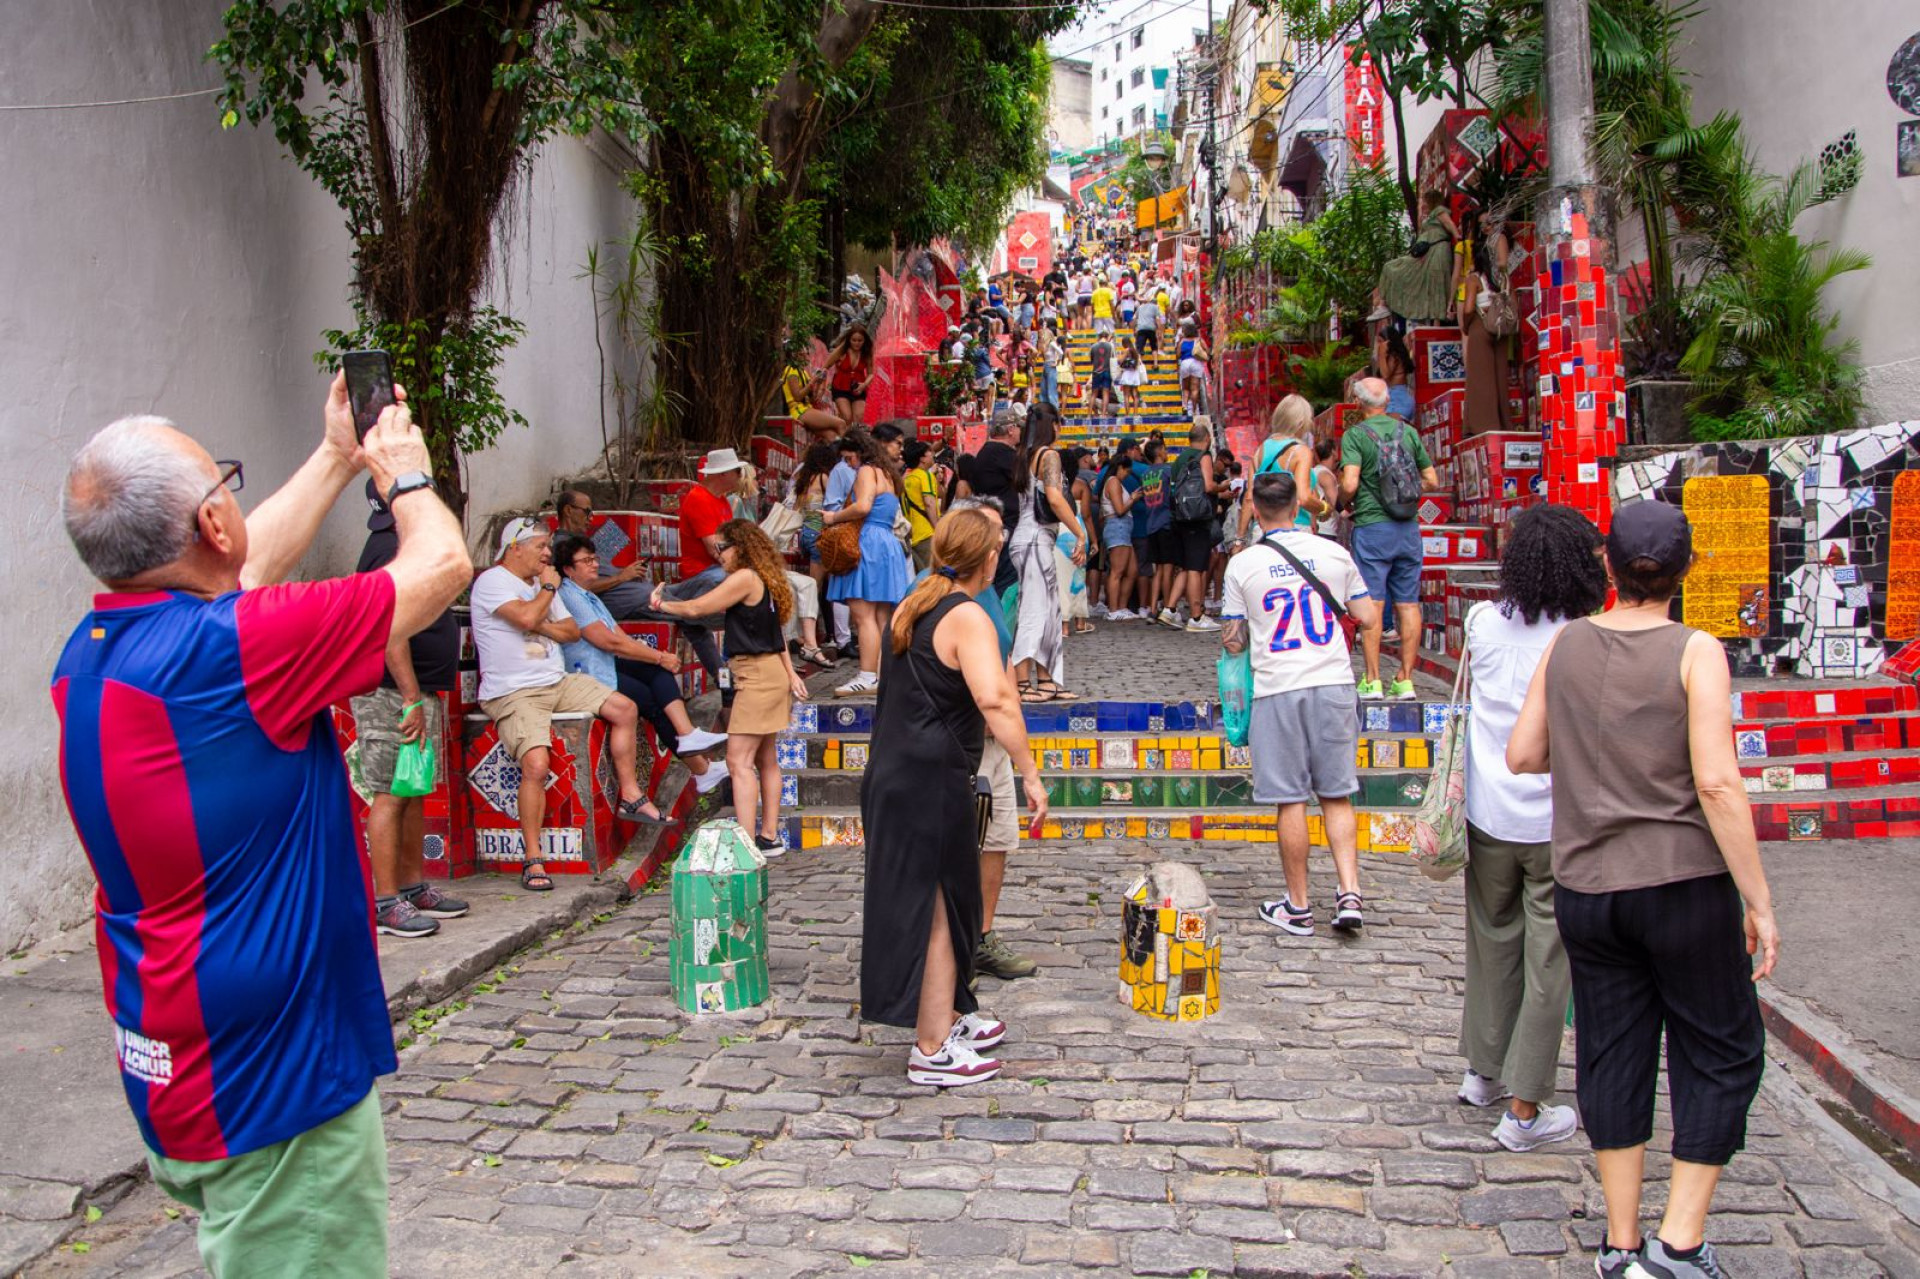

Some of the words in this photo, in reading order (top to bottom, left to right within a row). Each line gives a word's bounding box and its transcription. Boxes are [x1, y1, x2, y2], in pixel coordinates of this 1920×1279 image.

[1268, 558, 1316, 578] ASSI
[1262, 583, 1334, 653] 20
[485, 834, 575, 855] BRAIL
[125, 1029, 172, 1058] UNHCR
[125, 1047, 173, 1077] ACNUR
